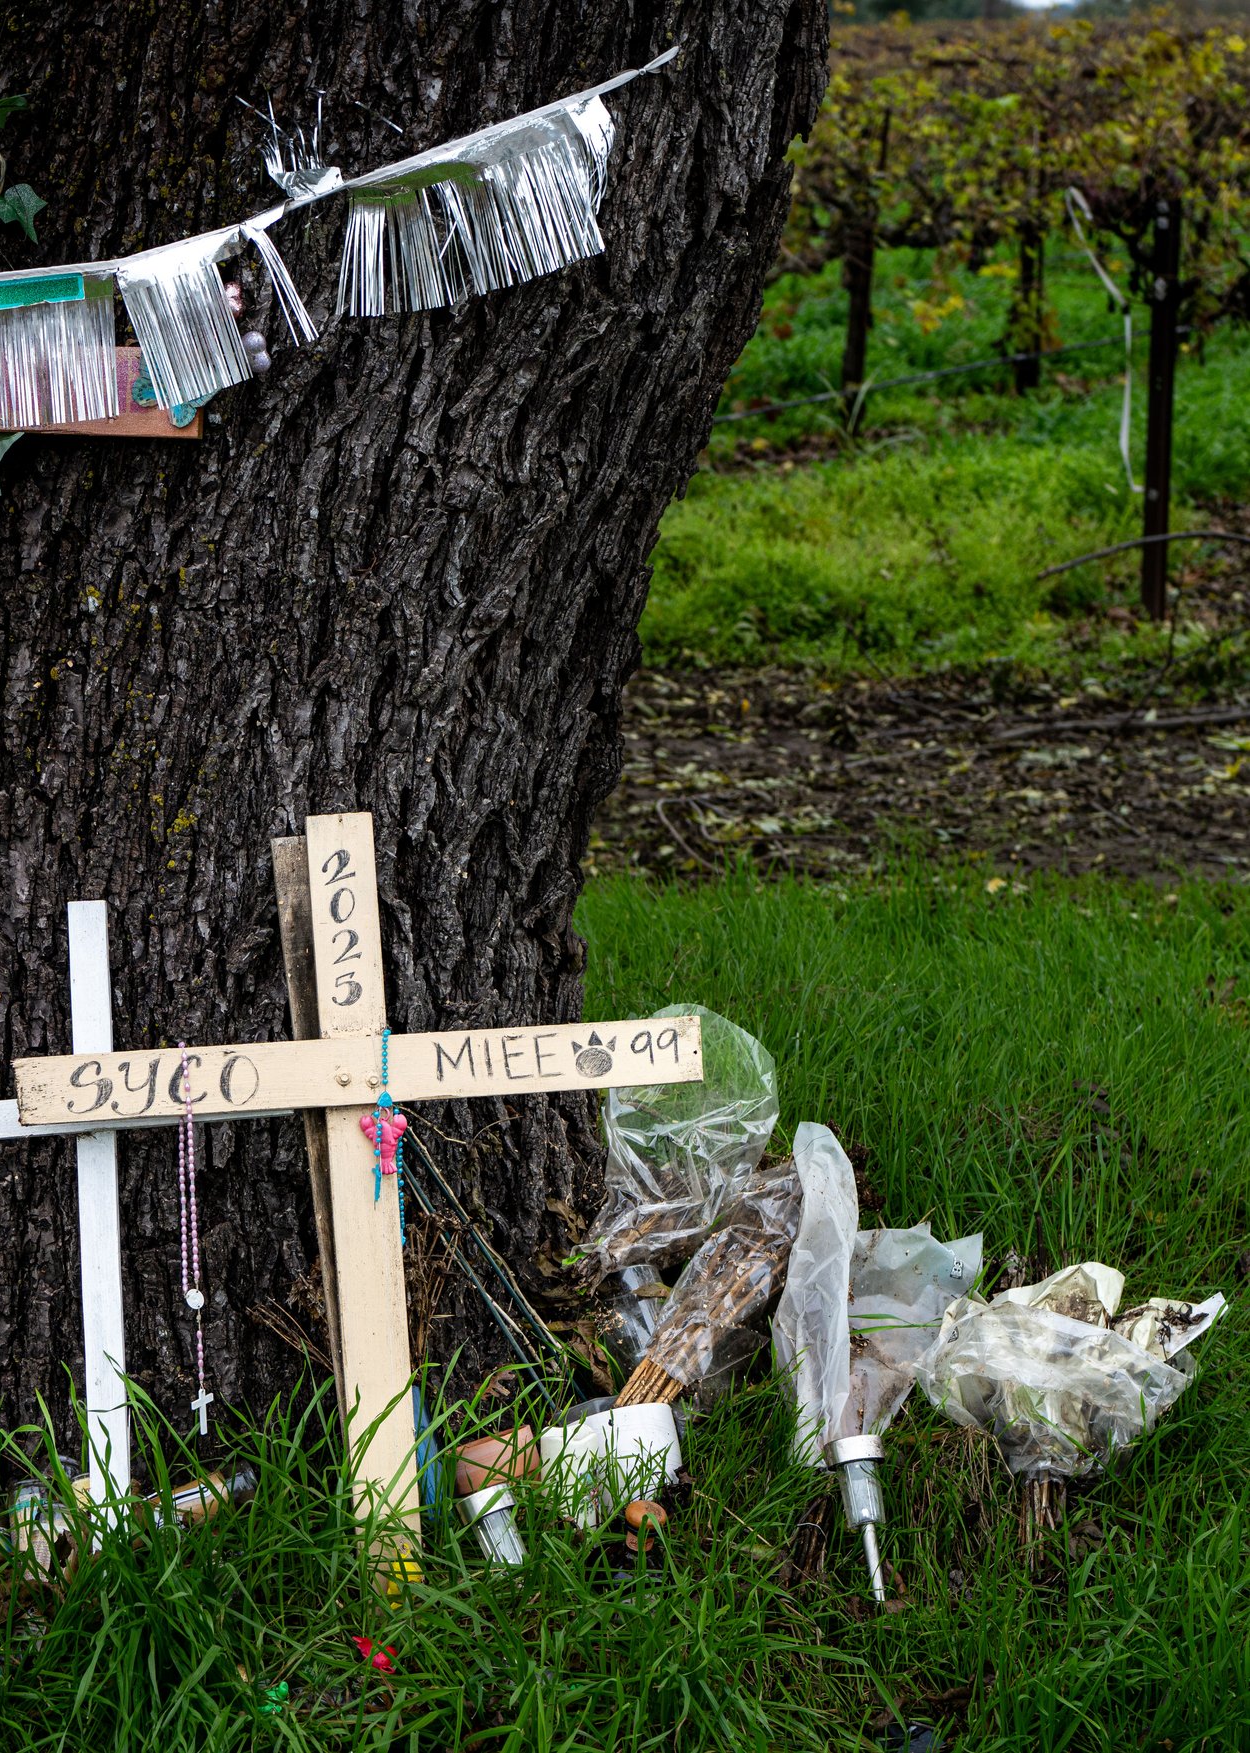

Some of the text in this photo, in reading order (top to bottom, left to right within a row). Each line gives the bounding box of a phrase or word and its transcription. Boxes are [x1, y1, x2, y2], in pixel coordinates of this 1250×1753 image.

[321, 849, 363, 1007] 2025
[67, 1027, 680, 1116] SYCO MIEE 99
